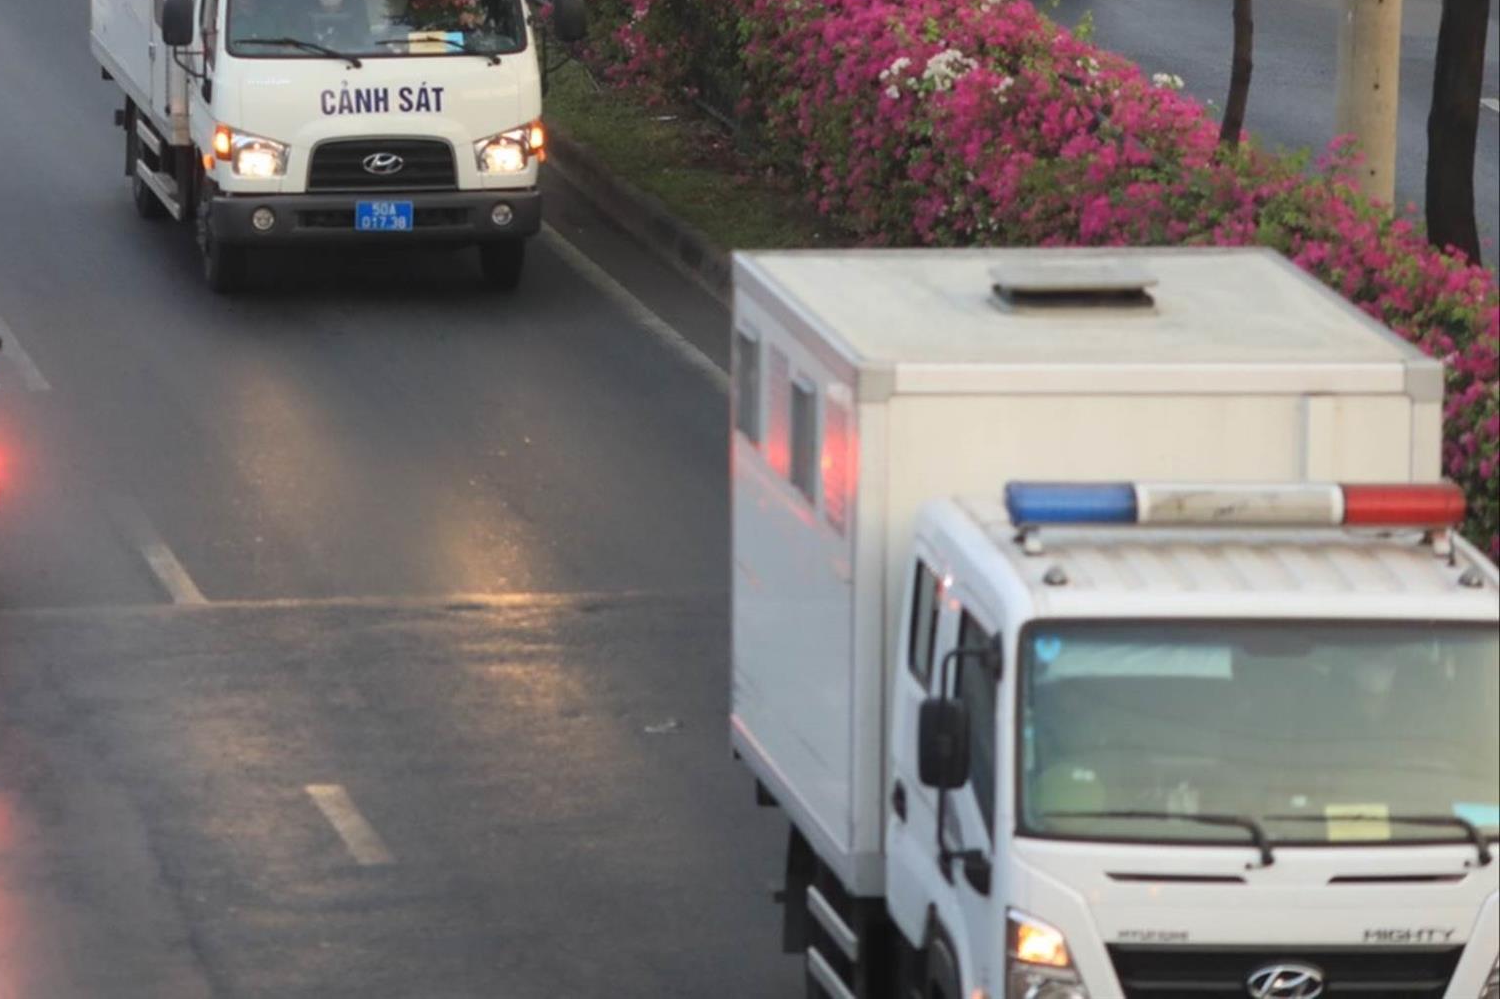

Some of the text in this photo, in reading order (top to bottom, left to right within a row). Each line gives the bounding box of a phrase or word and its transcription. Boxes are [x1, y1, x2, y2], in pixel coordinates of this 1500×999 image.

[320, 79, 445, 116] CẢNH SÁT
[371, 204, 397, 215] 50A
[1361, 928, 1455, 942] MIGHTY
